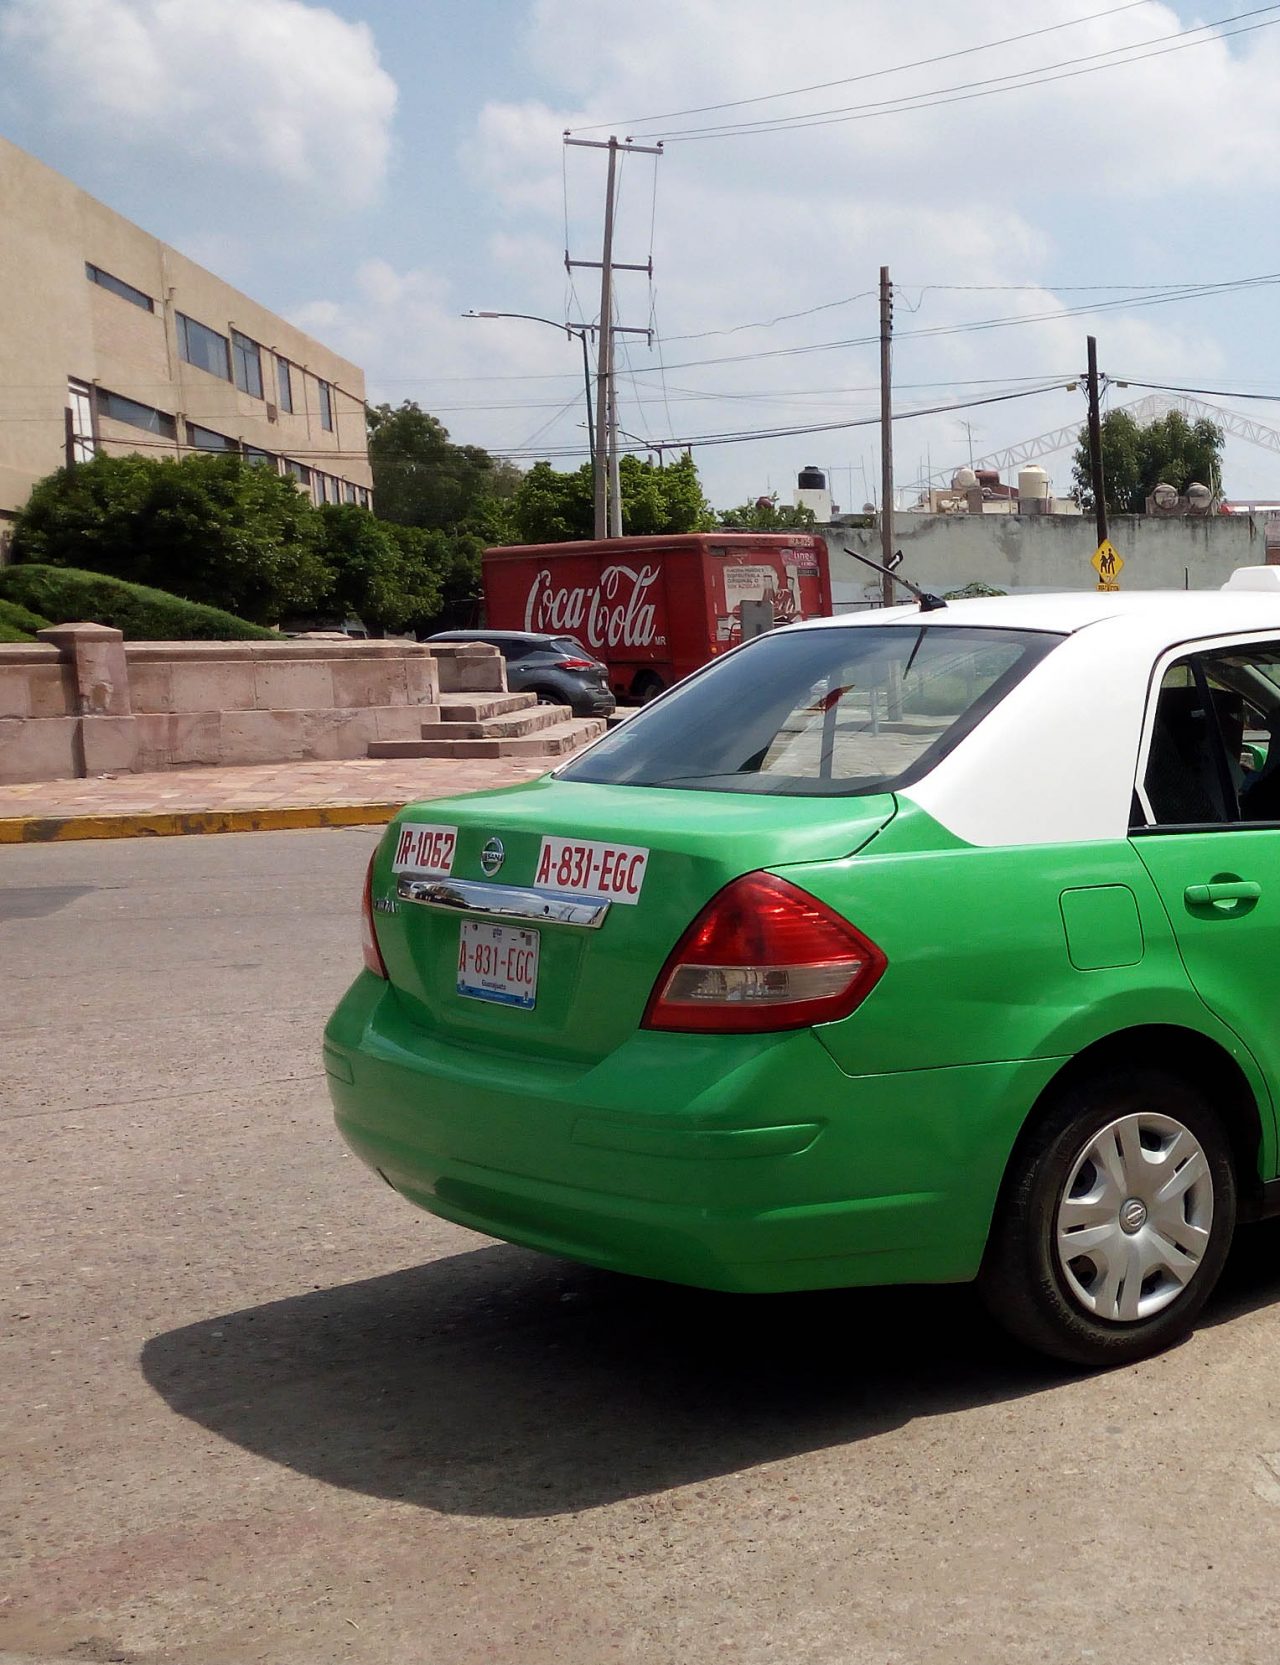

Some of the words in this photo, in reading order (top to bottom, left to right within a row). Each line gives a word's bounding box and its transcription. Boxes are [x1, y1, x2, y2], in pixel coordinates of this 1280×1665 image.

[525, 565, 661, 648] Coca-Cola
[395, 830, 456, 870] IR-1062
[535, 843, 646, 895] A-831-EGC
[458, 940, 535, 986] A-831-EGC
